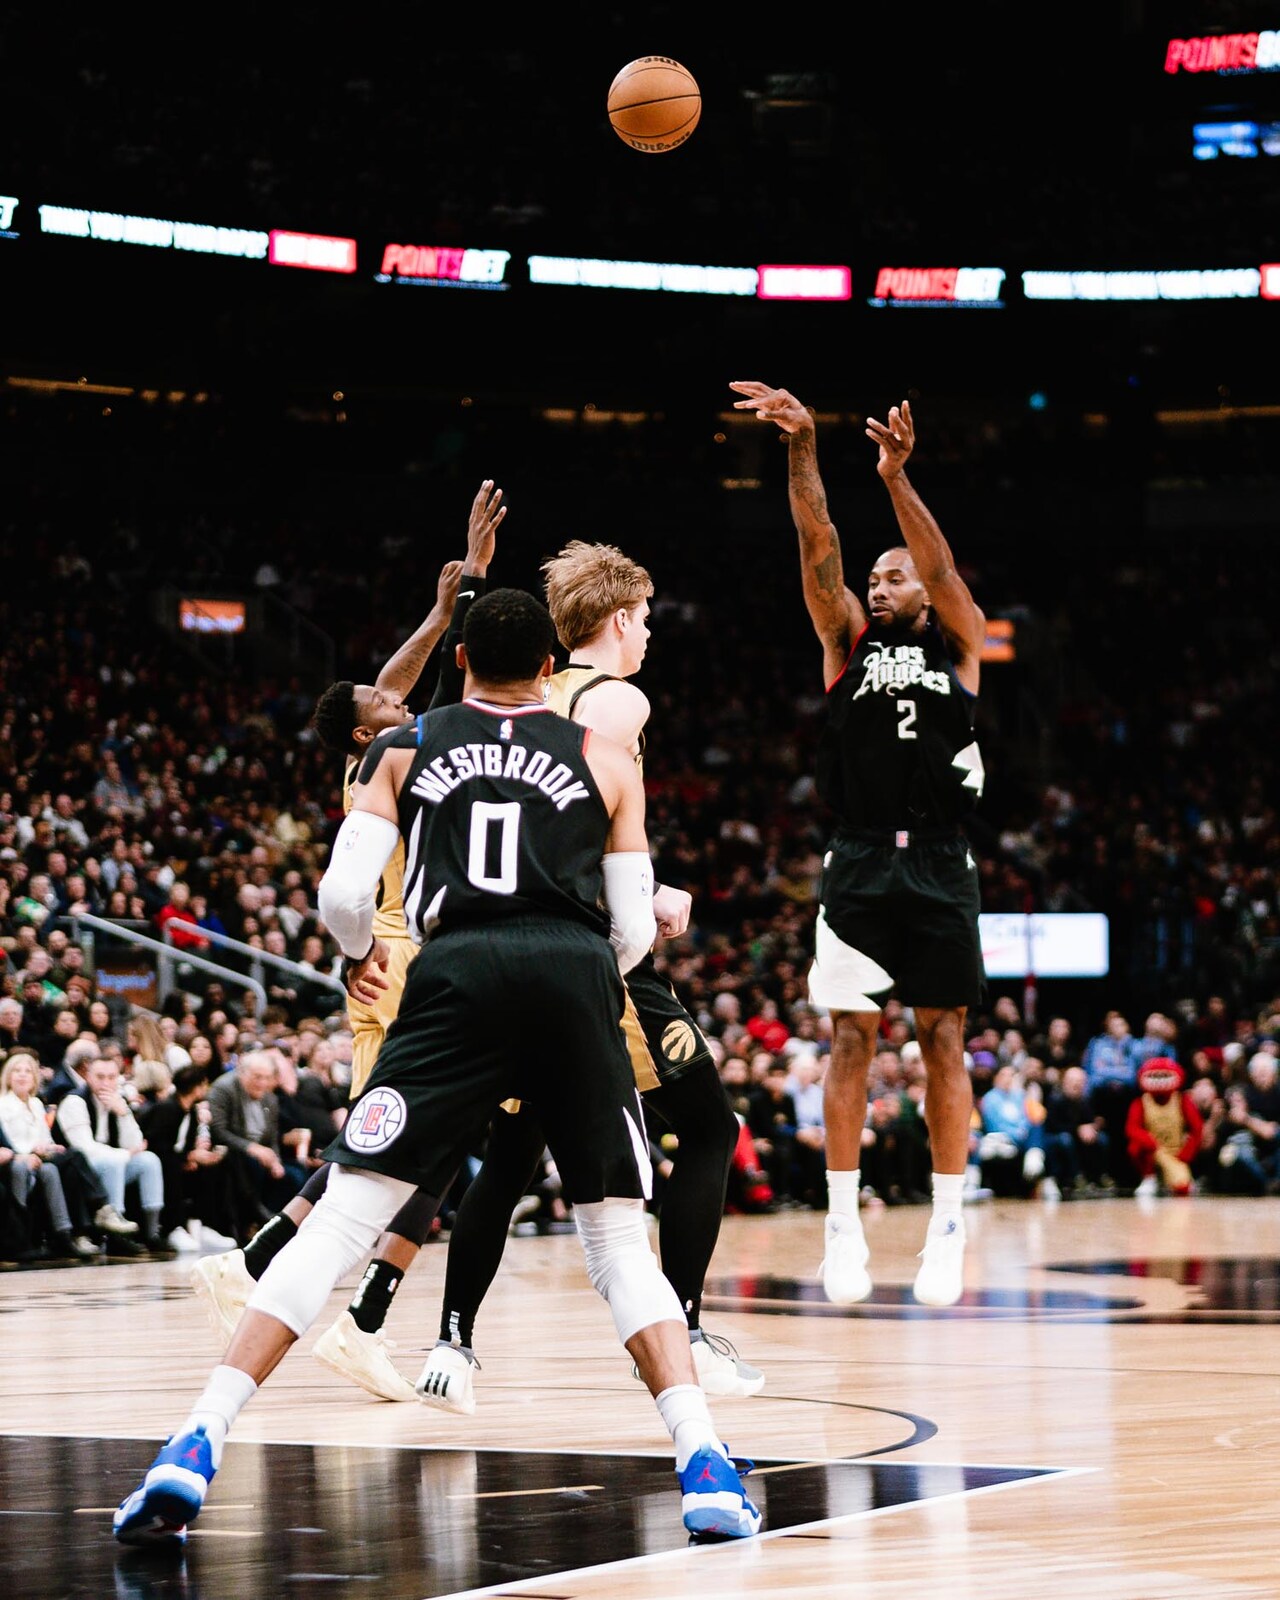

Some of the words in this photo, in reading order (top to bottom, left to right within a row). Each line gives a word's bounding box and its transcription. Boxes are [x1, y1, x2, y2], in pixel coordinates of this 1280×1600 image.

[852, 652, 951, 700] Angeles
[868, 641, 926, 665] Los
[897, 699, 917, 739] 2
[410, 743, 590, 811] WESTBROOK
[468, 801, 521, 895] 0
